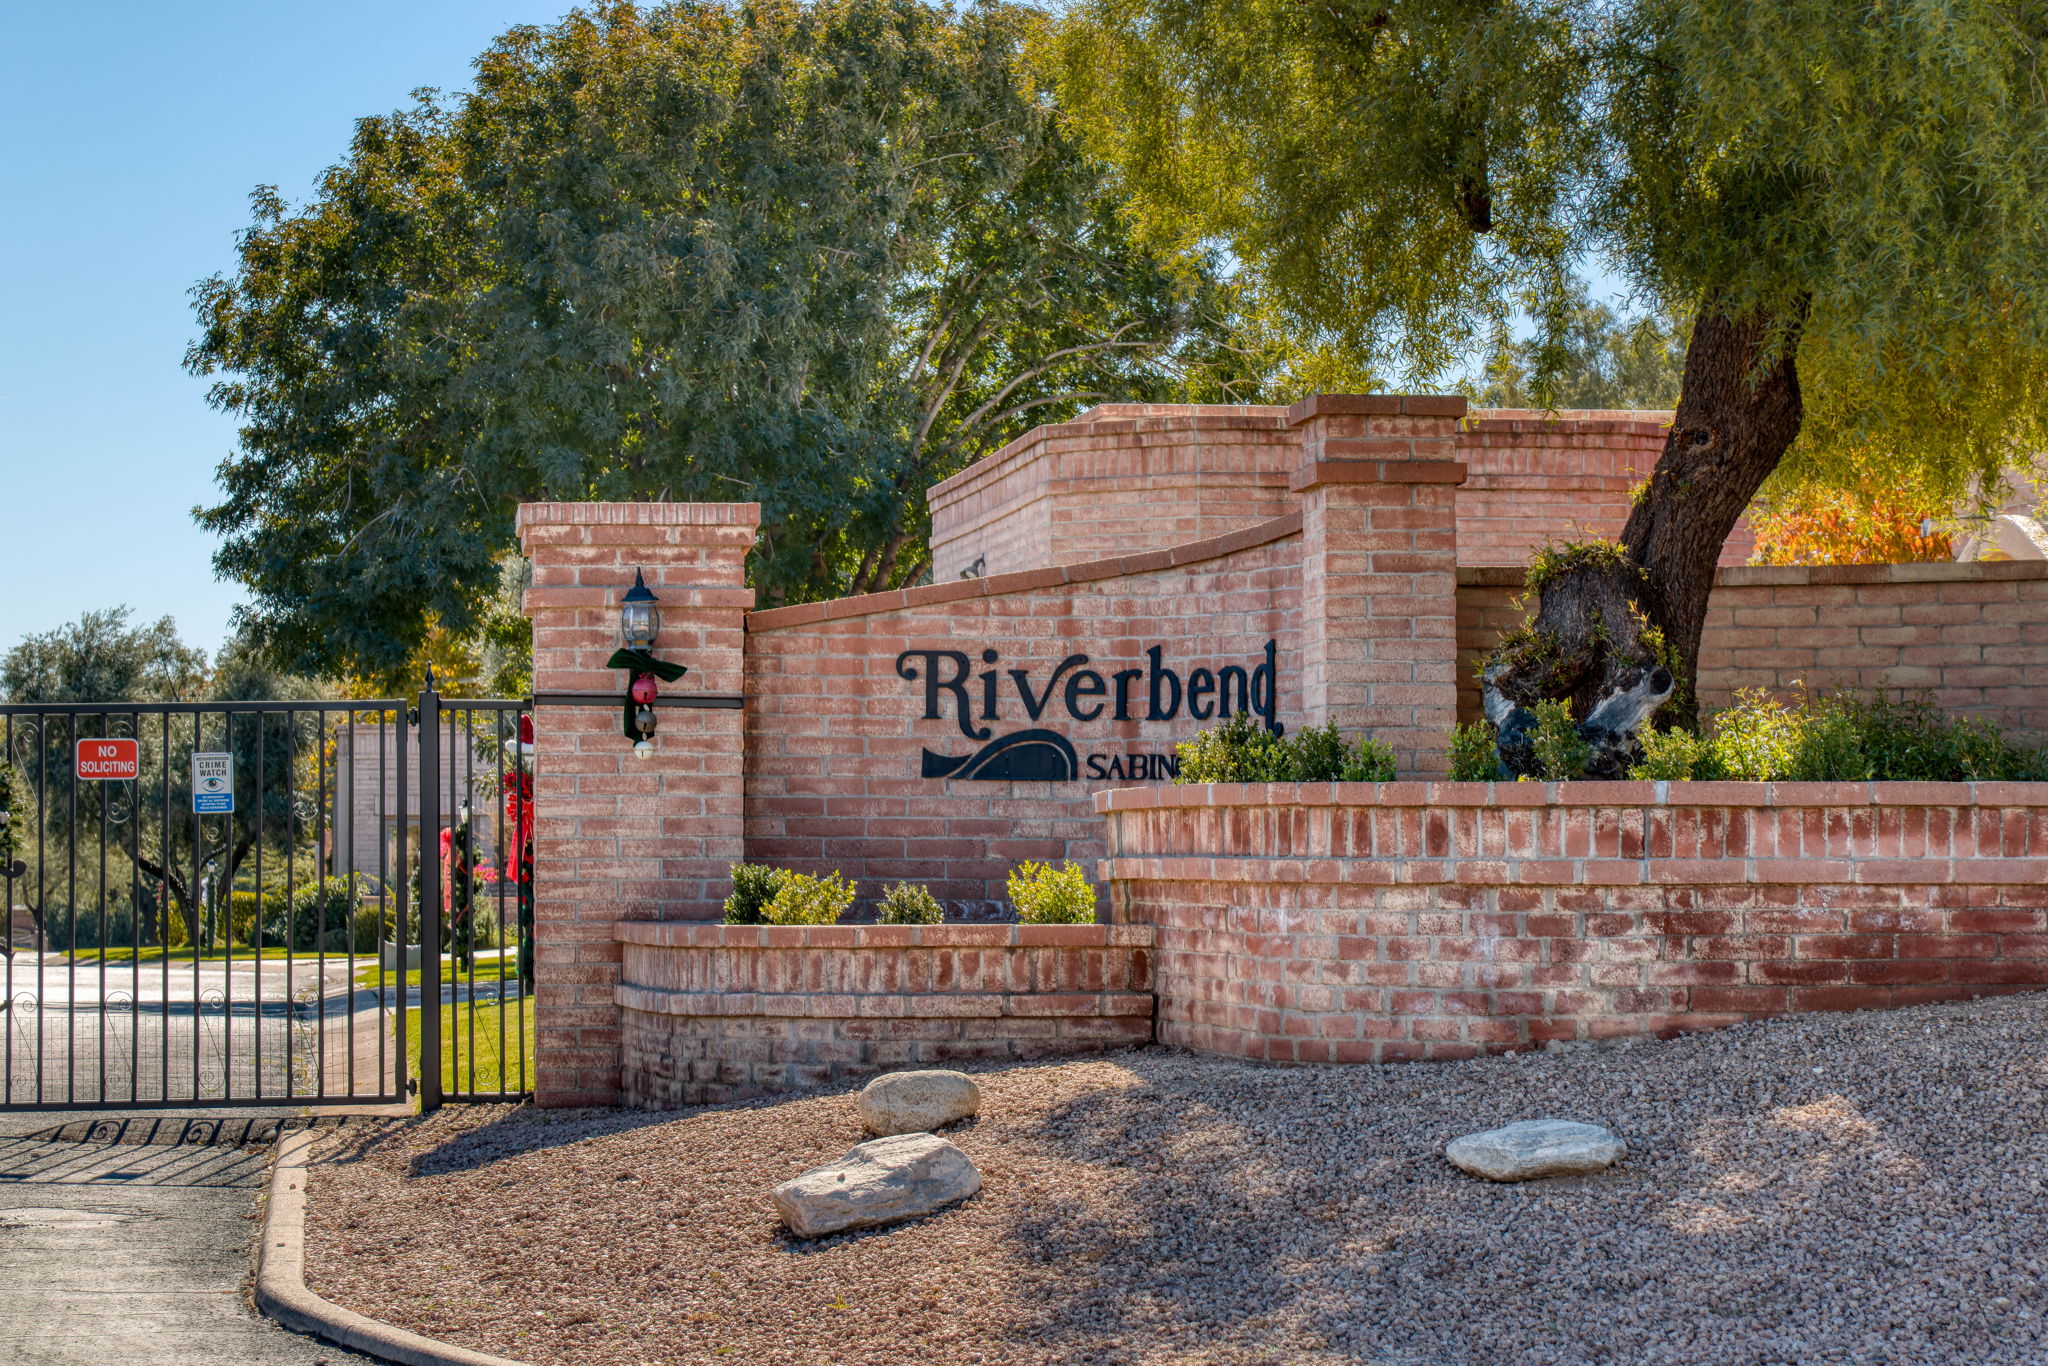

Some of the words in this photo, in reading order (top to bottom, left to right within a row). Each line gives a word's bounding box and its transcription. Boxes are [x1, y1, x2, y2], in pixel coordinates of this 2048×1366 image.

[896, 638, 1284, 741] Riverbend
[98, 745, 118, 758] NO
[80, 760, 135, 774] SOLICITING
[199, 761, 227, 769] CRIME
[199, 769, 227, 777] WATCH
